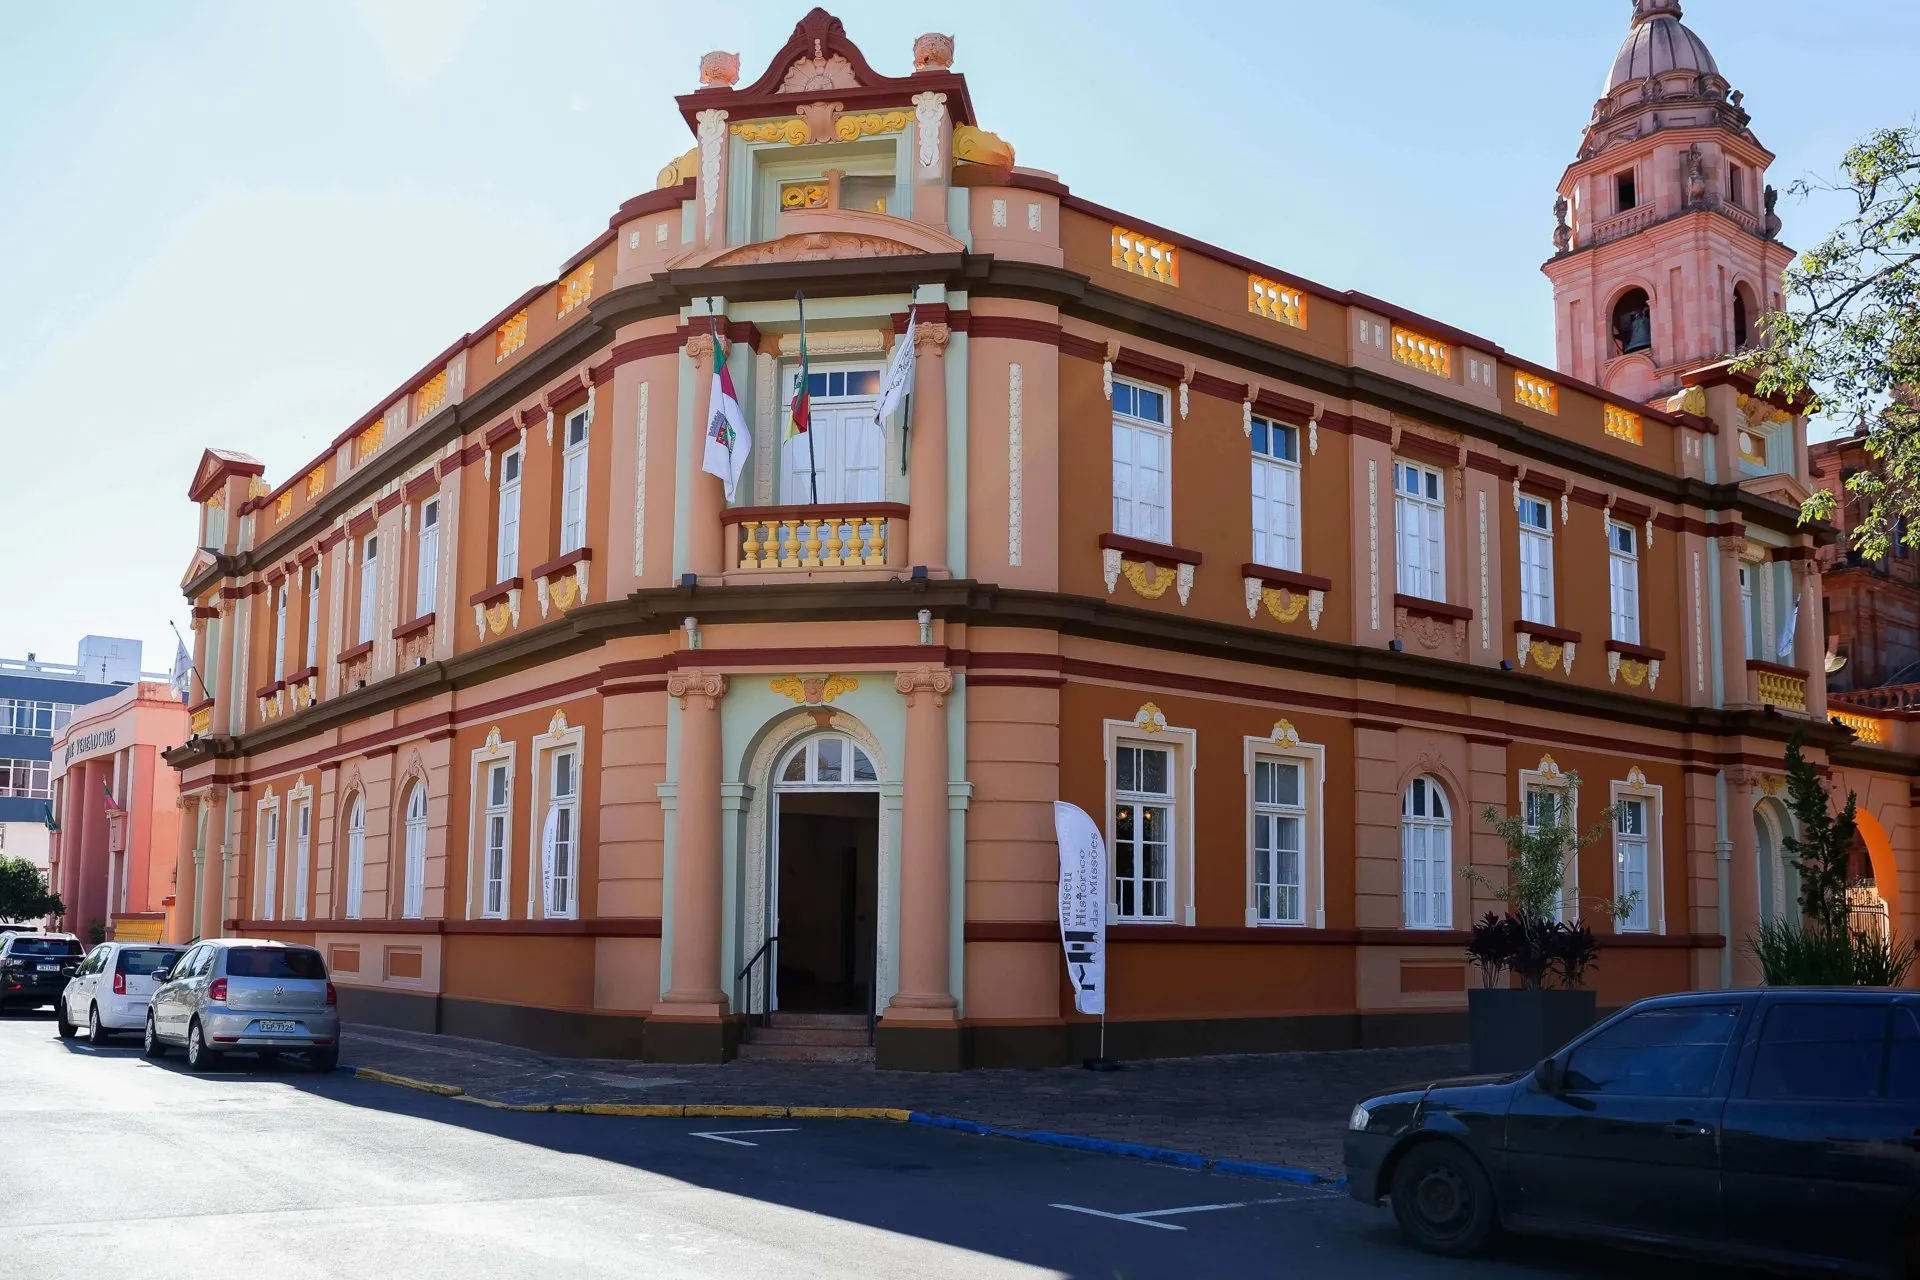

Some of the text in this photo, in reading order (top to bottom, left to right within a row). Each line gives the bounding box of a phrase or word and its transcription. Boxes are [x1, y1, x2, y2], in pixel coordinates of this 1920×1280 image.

[1062, 872, 1073, 929] Museu
[1075, 849, 1087, 926] Histórico
[1089, 832, 1099, 927] das Missões
